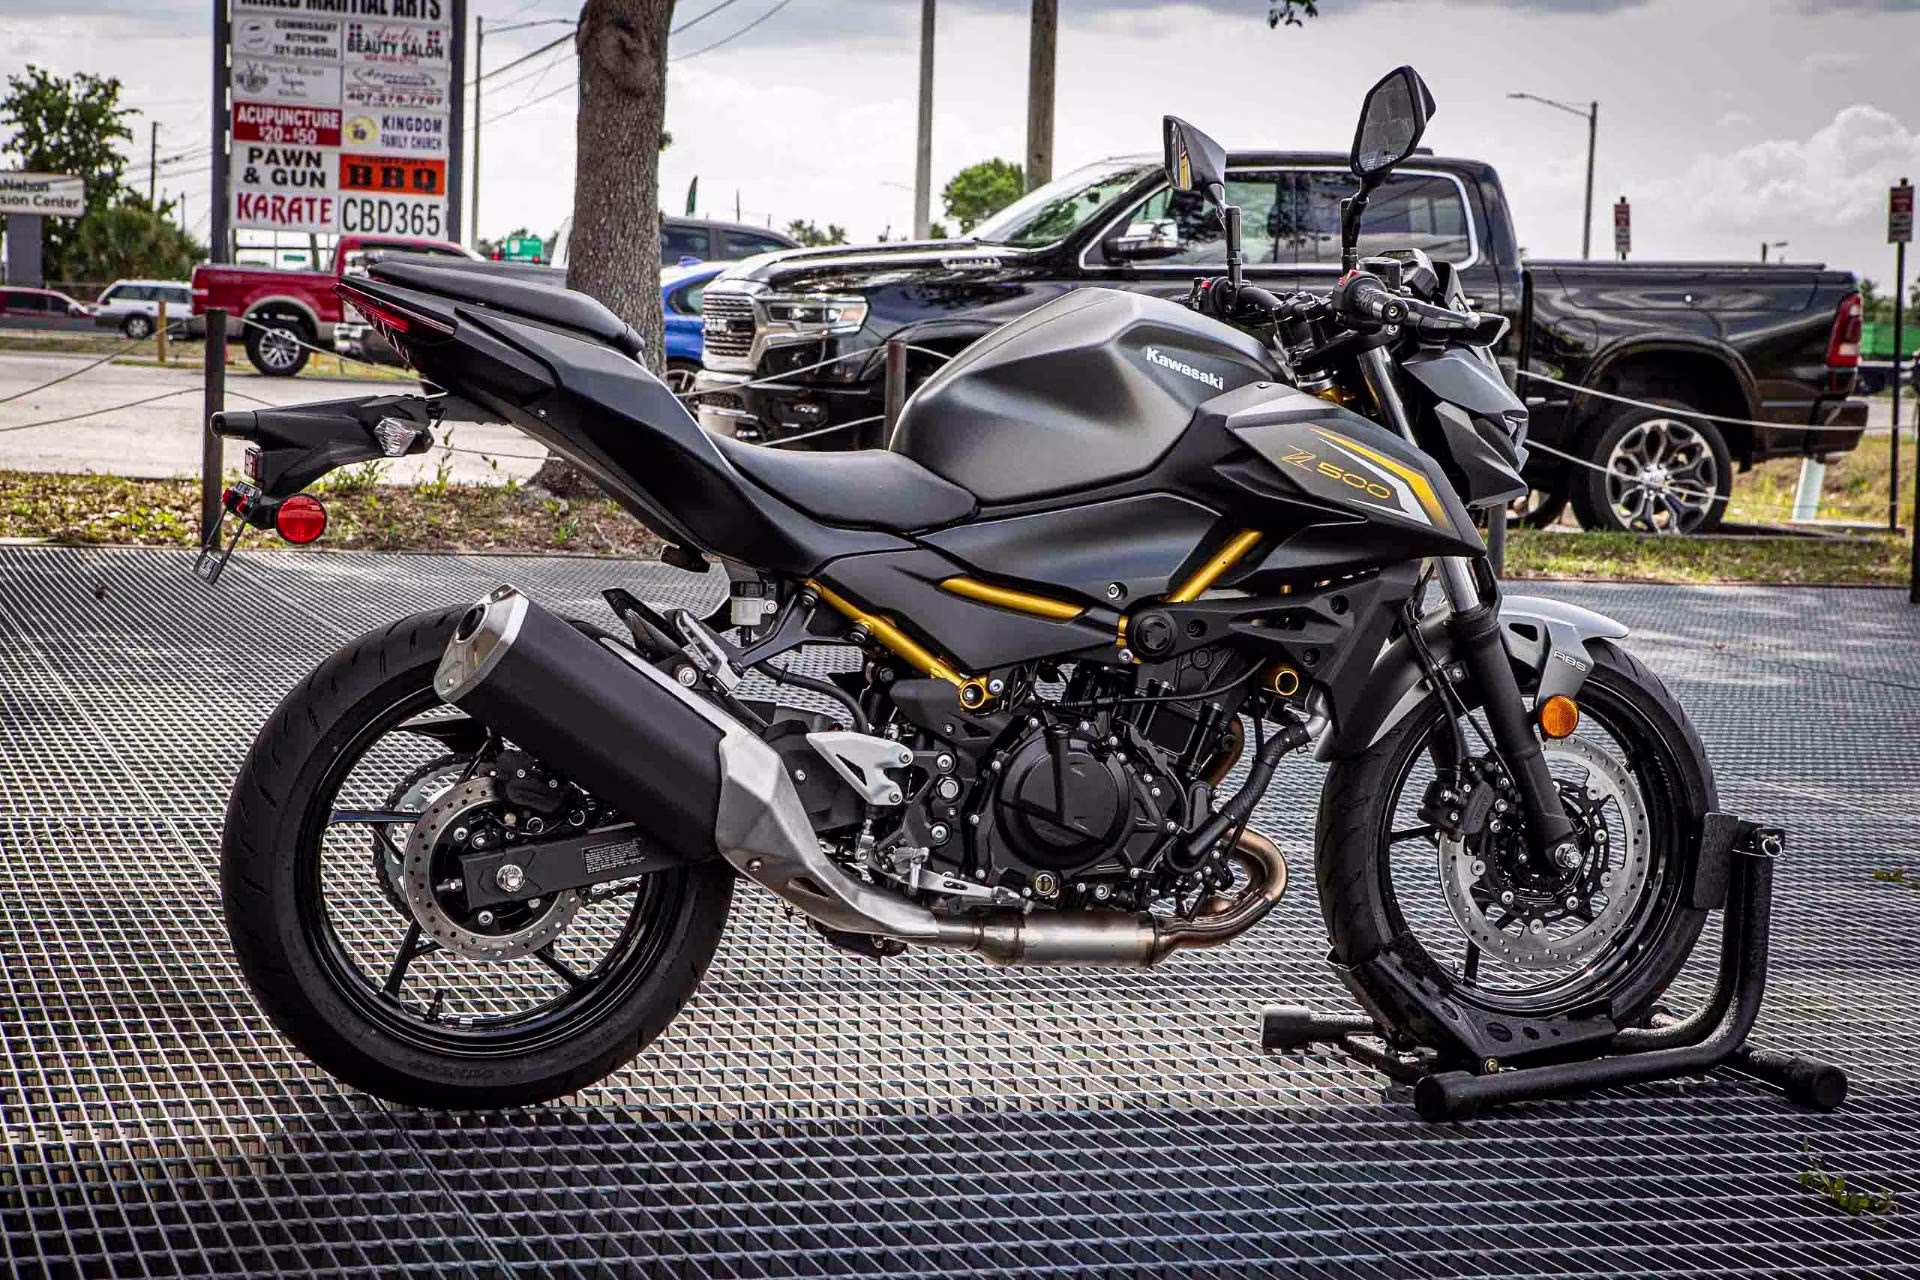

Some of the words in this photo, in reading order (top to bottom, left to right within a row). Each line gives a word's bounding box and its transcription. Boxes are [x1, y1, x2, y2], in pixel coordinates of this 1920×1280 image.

[285, 33, 327, 43] KITCHEN
[347, 37, 399, 54] BEAUTY
[402, 42, 443, 58] SALON
[237, 105, 340, 129] ACUPUNCTURE
[382, 114, 442, 132] KINGDOM
[248, 146, 322, 169] PAWN
[243, 166, 261, 185] &
[271, 168, 326, 189] GUN
[348, 164, 437, 193] BBQ
[33, 194, 79, 208] Center
[237, 191, 333, 225] KARATE
[343, 198, 440, 236] CBD365
[1146, 346, 1224, 391] Kawasaki
[1553, 650, 1586, 672] ABS
